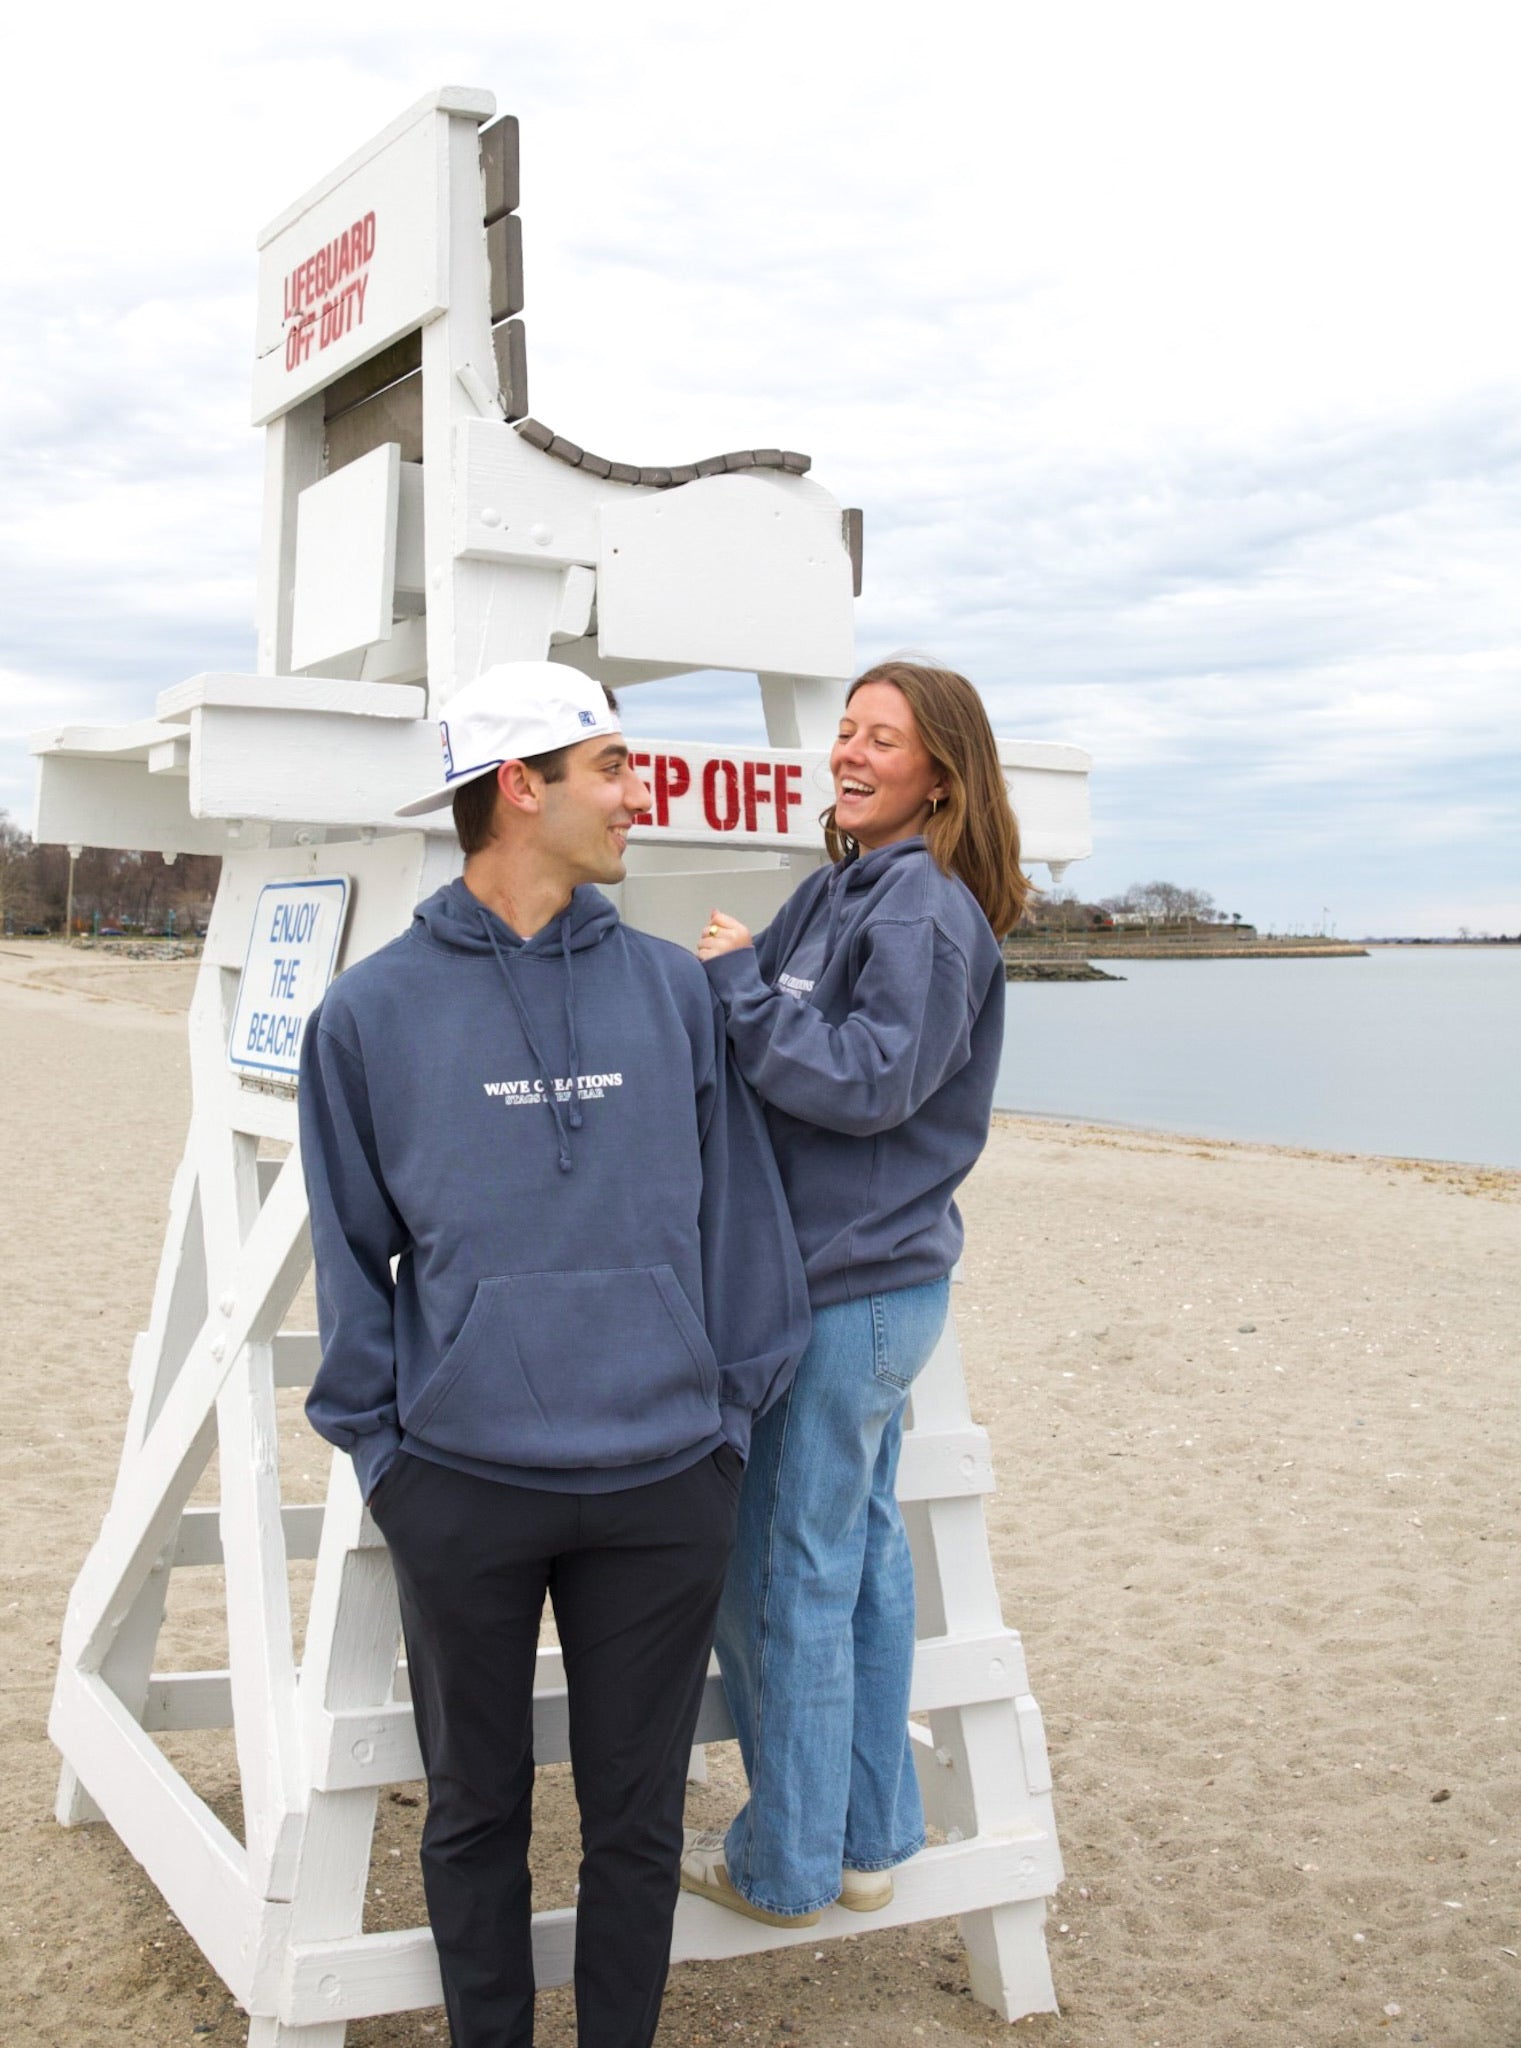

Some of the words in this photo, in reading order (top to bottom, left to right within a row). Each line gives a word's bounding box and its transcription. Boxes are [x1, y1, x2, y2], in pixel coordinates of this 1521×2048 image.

[284, 210, 376, 321] LIFEGUARD
[285, 311, 317, 372] OFF
[320, 272, 369, 351] DUTY
[703, 759, 802, 833] OFF
[269, 902, 320, 943] ENJOY
[270, 959, 300, 1000] THE
[246, 1012, 302, 1057] BEACH!
[483, 1080, 530, 1096] WAVE
[533, 1073, 623, 1093] CEATIONS
